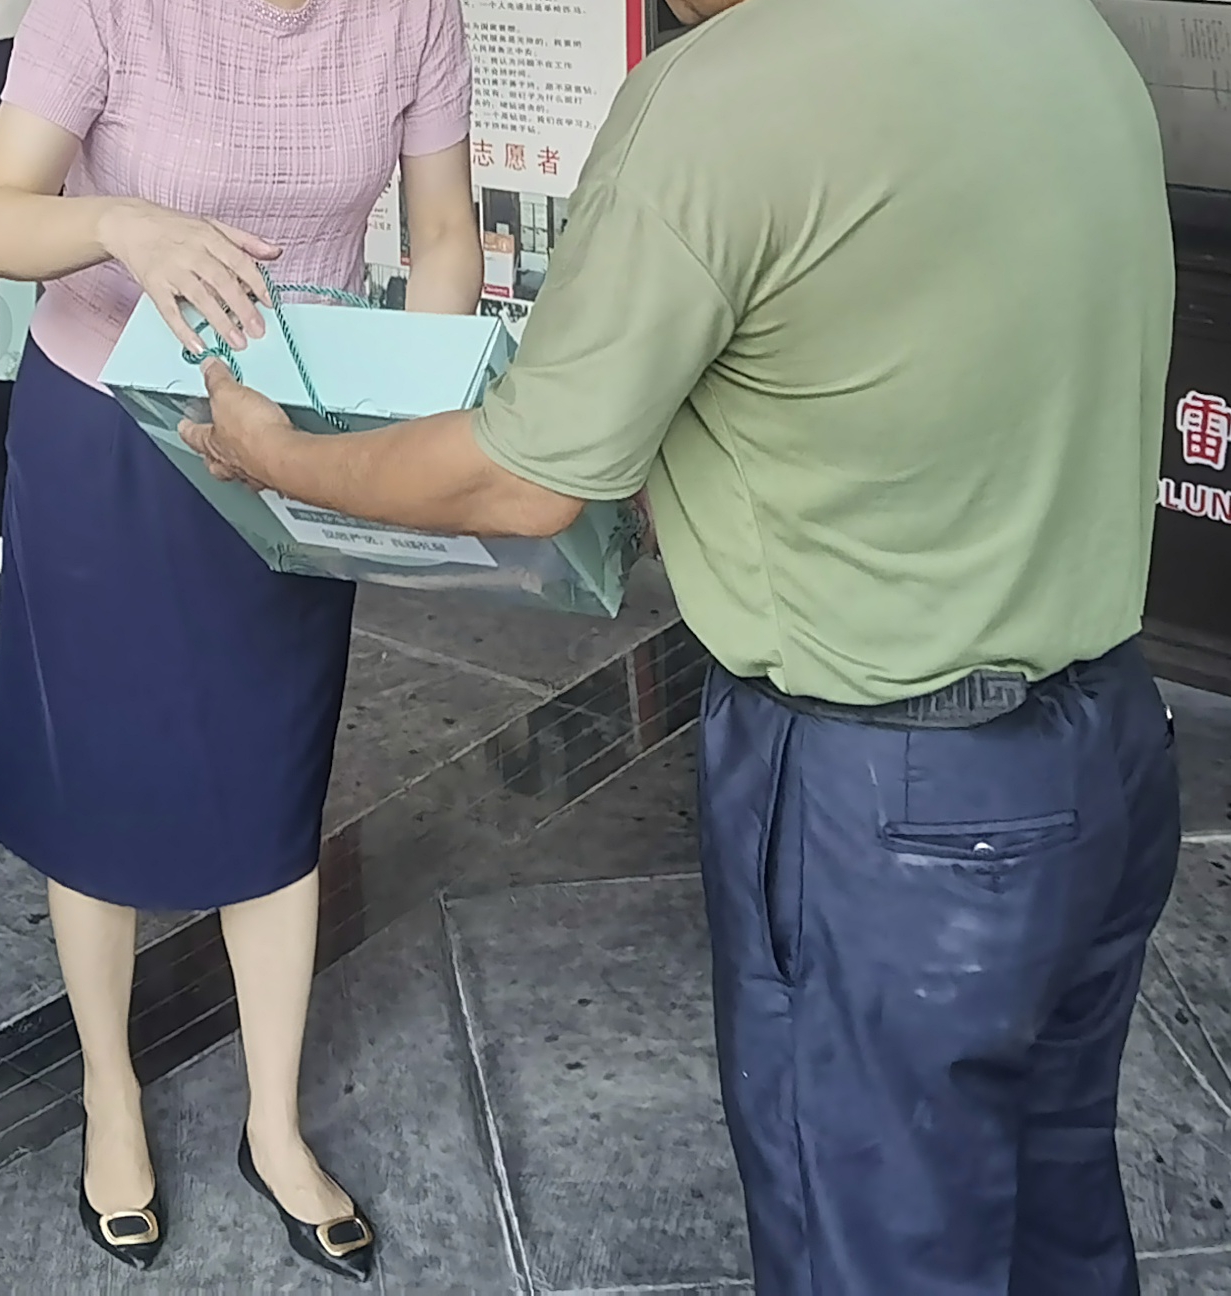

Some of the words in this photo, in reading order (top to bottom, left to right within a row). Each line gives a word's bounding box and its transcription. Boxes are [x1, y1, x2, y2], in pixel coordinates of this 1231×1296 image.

[473, 139, 560, 175] 志愿者
[1177, 390, 1231, 470] 雷
